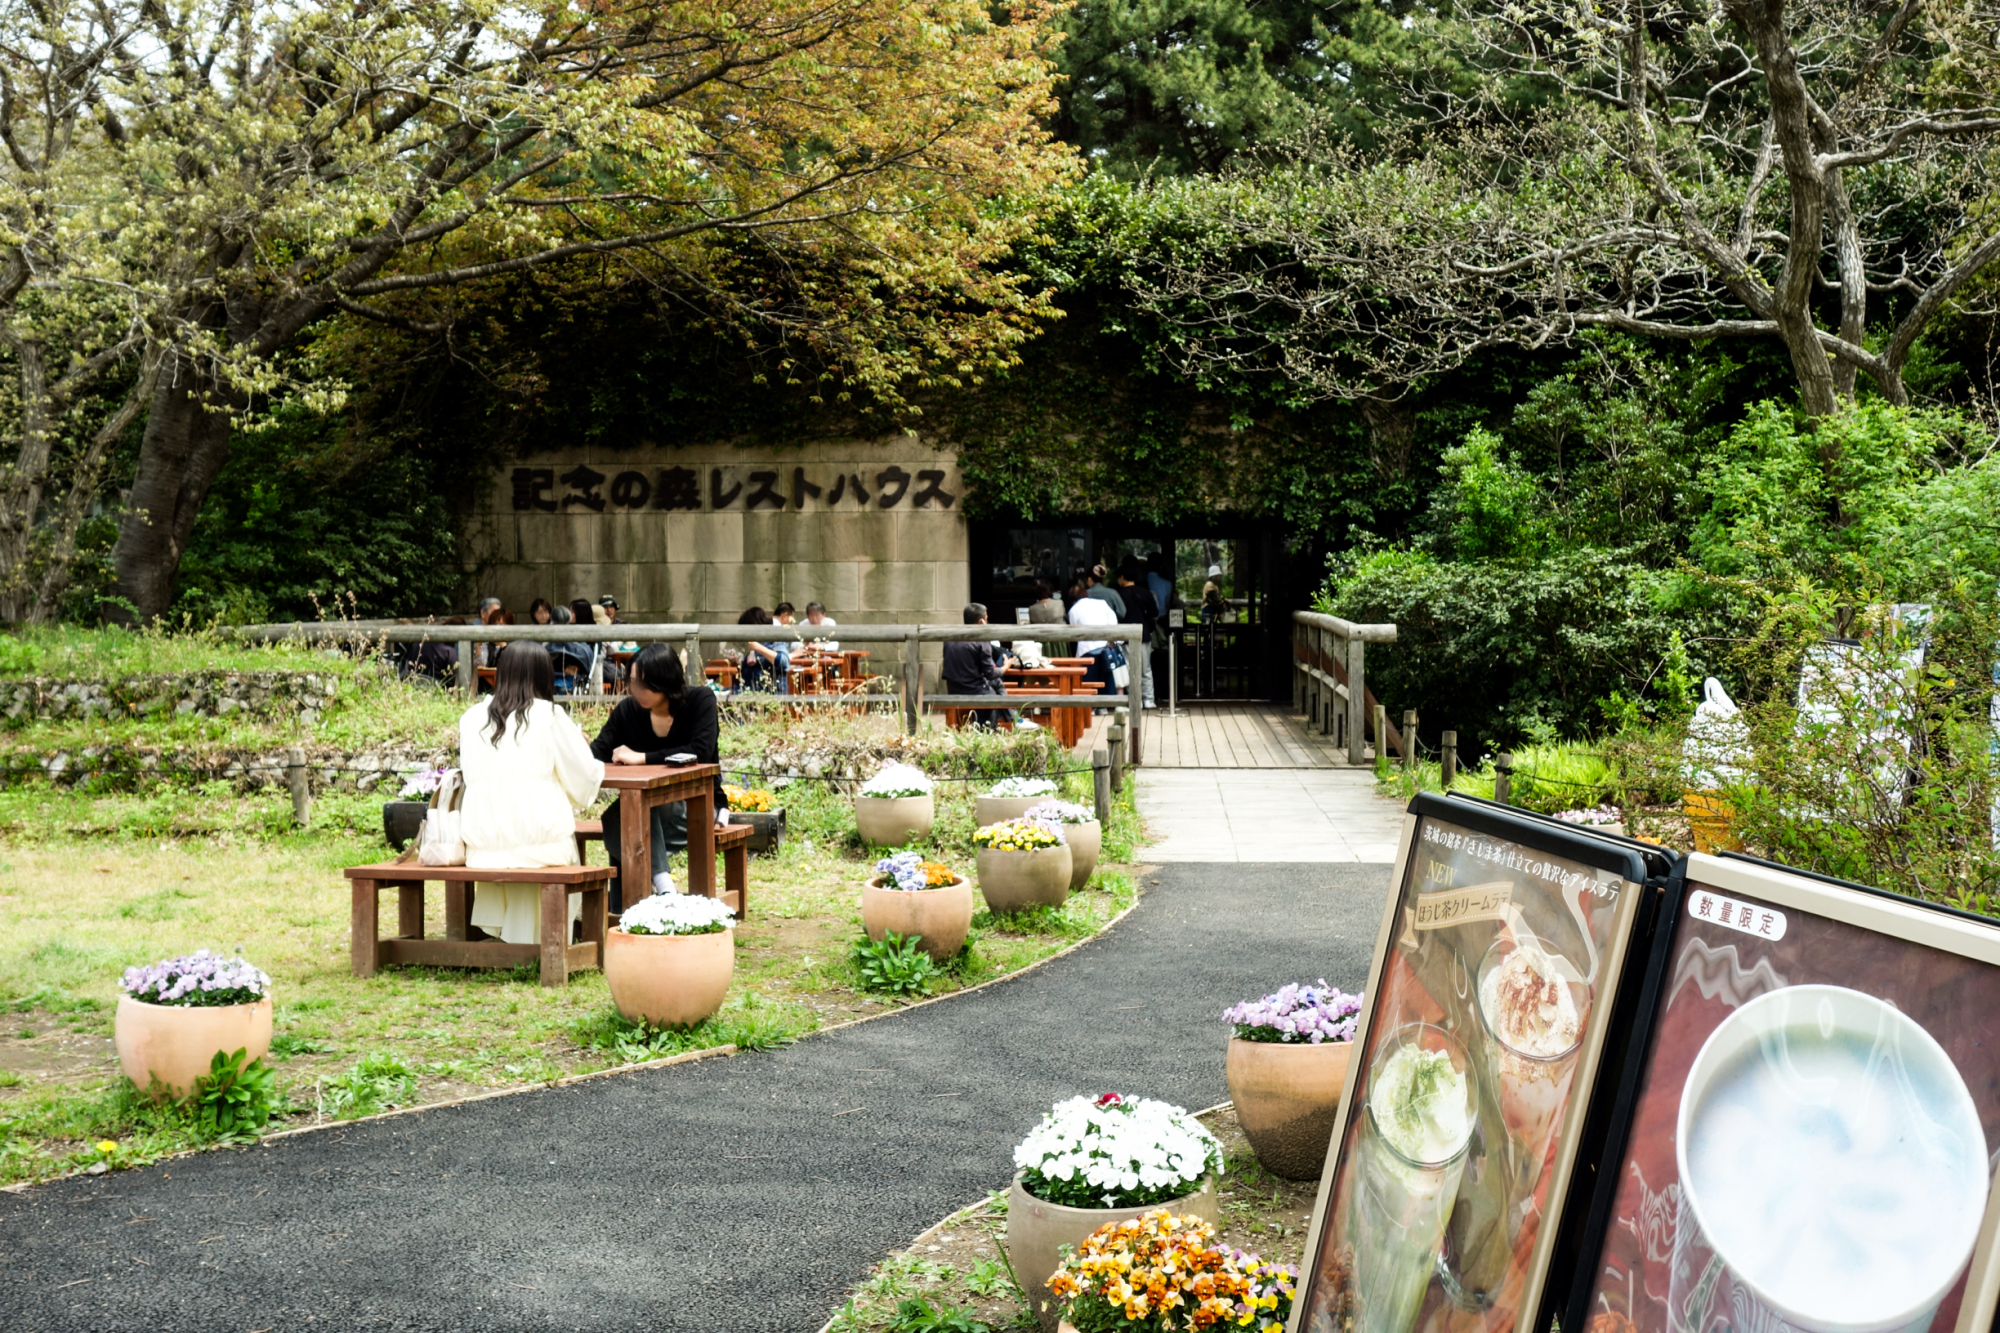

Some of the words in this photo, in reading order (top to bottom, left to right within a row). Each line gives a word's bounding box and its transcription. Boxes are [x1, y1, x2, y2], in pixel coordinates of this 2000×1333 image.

[510, 464, 955, 512] 記念の森レストハウス
[1426, 860, 1458, 887] NEW
[1418, 892, 1509, 922] ほうじ茶クリームラテ
[1699, 896, 1774, 935] 数量限定
